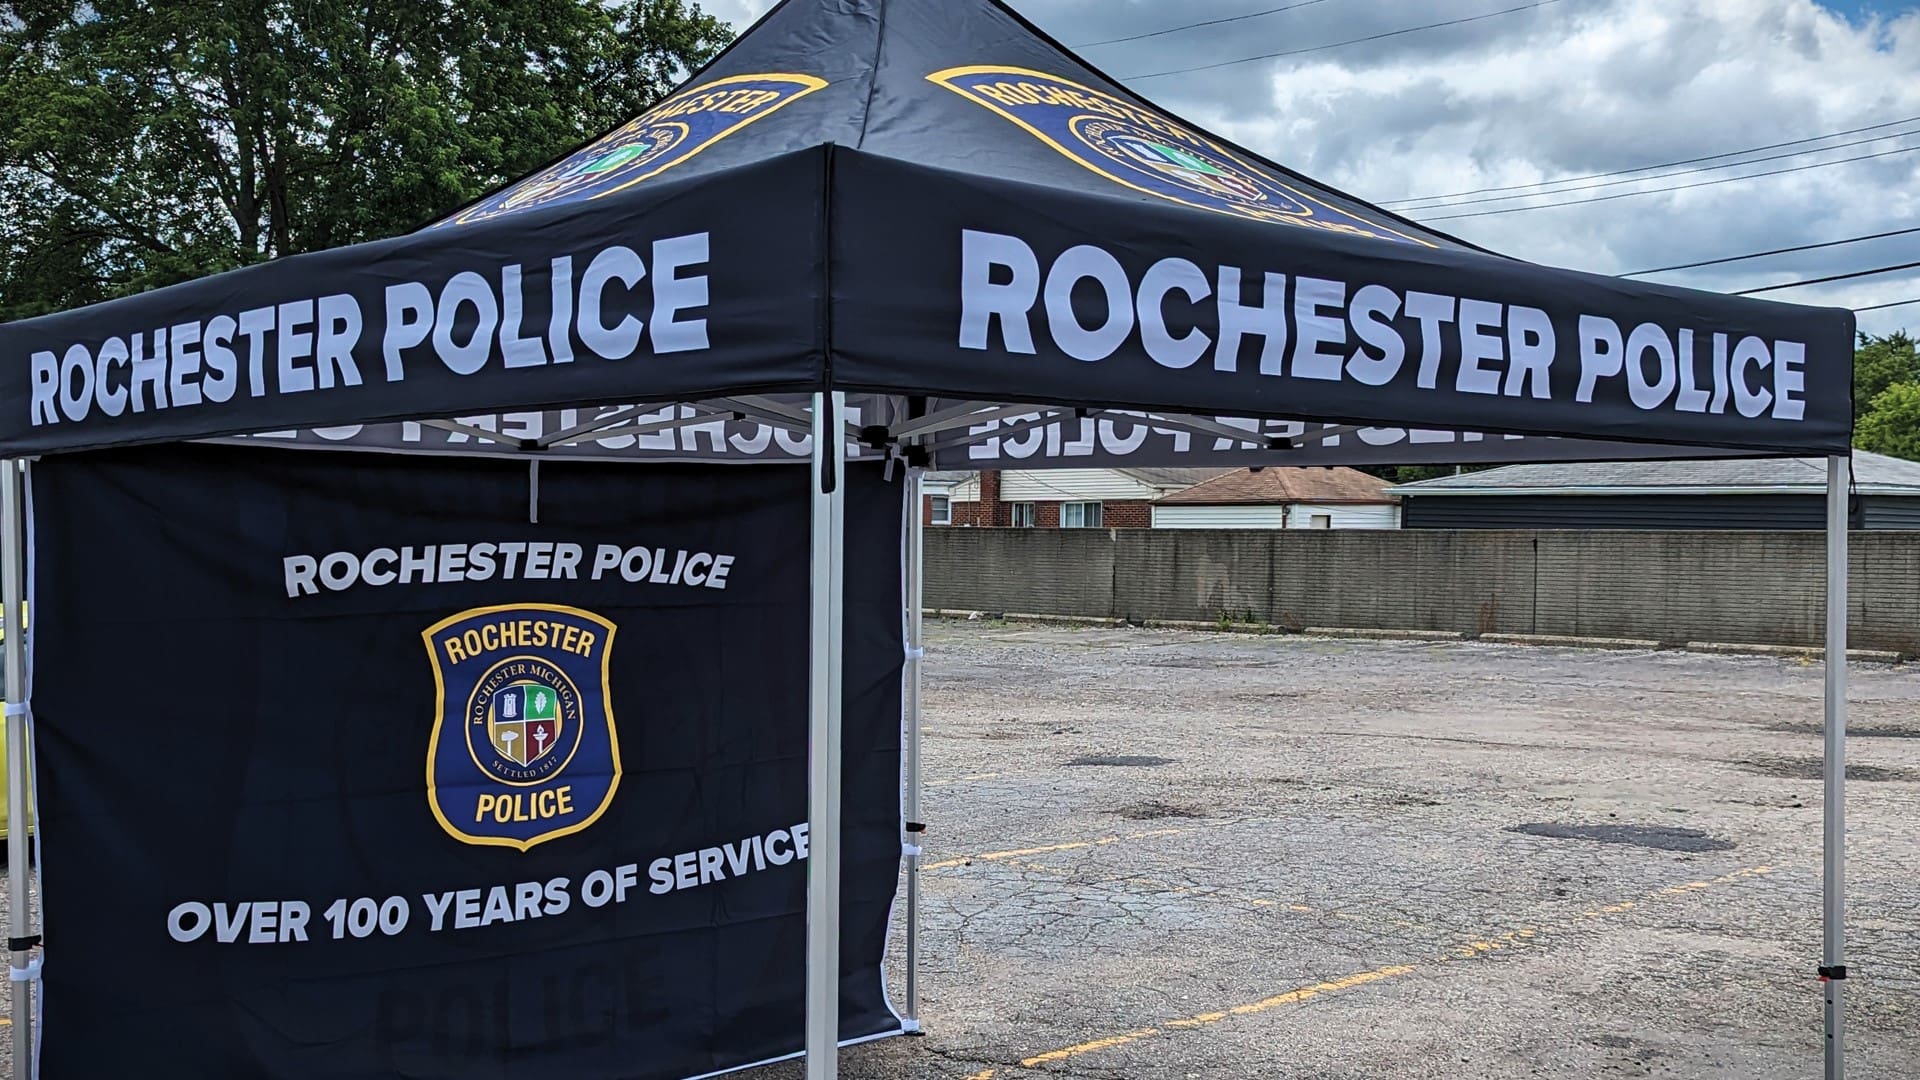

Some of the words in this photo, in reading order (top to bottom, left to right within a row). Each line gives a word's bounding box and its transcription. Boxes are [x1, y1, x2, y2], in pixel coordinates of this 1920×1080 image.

[30, 292, 363, 426] ROCHESTER
[383, 231, 710, 381] POLICE
[958, 228, 1556, 400] ROCHESTER
[1575, 313, 1806, 420] POLICE
[283, 542, 582, 597] ROCHESTER
[591, 544, 736, 589] POLICE
[444, 620, 595, 665] ROCHESTER
[473, 663, 526, 725] ROCHESTER
[529, 663, 576, 720] MICHIGAN
[492, 759, 536, 778] SETTLED
[539, 755, 558, 773] 1817
[475, 785, 574, 823] POLICE
[167, 900, 311, 944] OVER
[323, 895, 410, 940] 100
[422, 877, 571, 932] YEARS
[581, 863, 638, 908] OF
[648, 822, 809, 895] SERVICE
